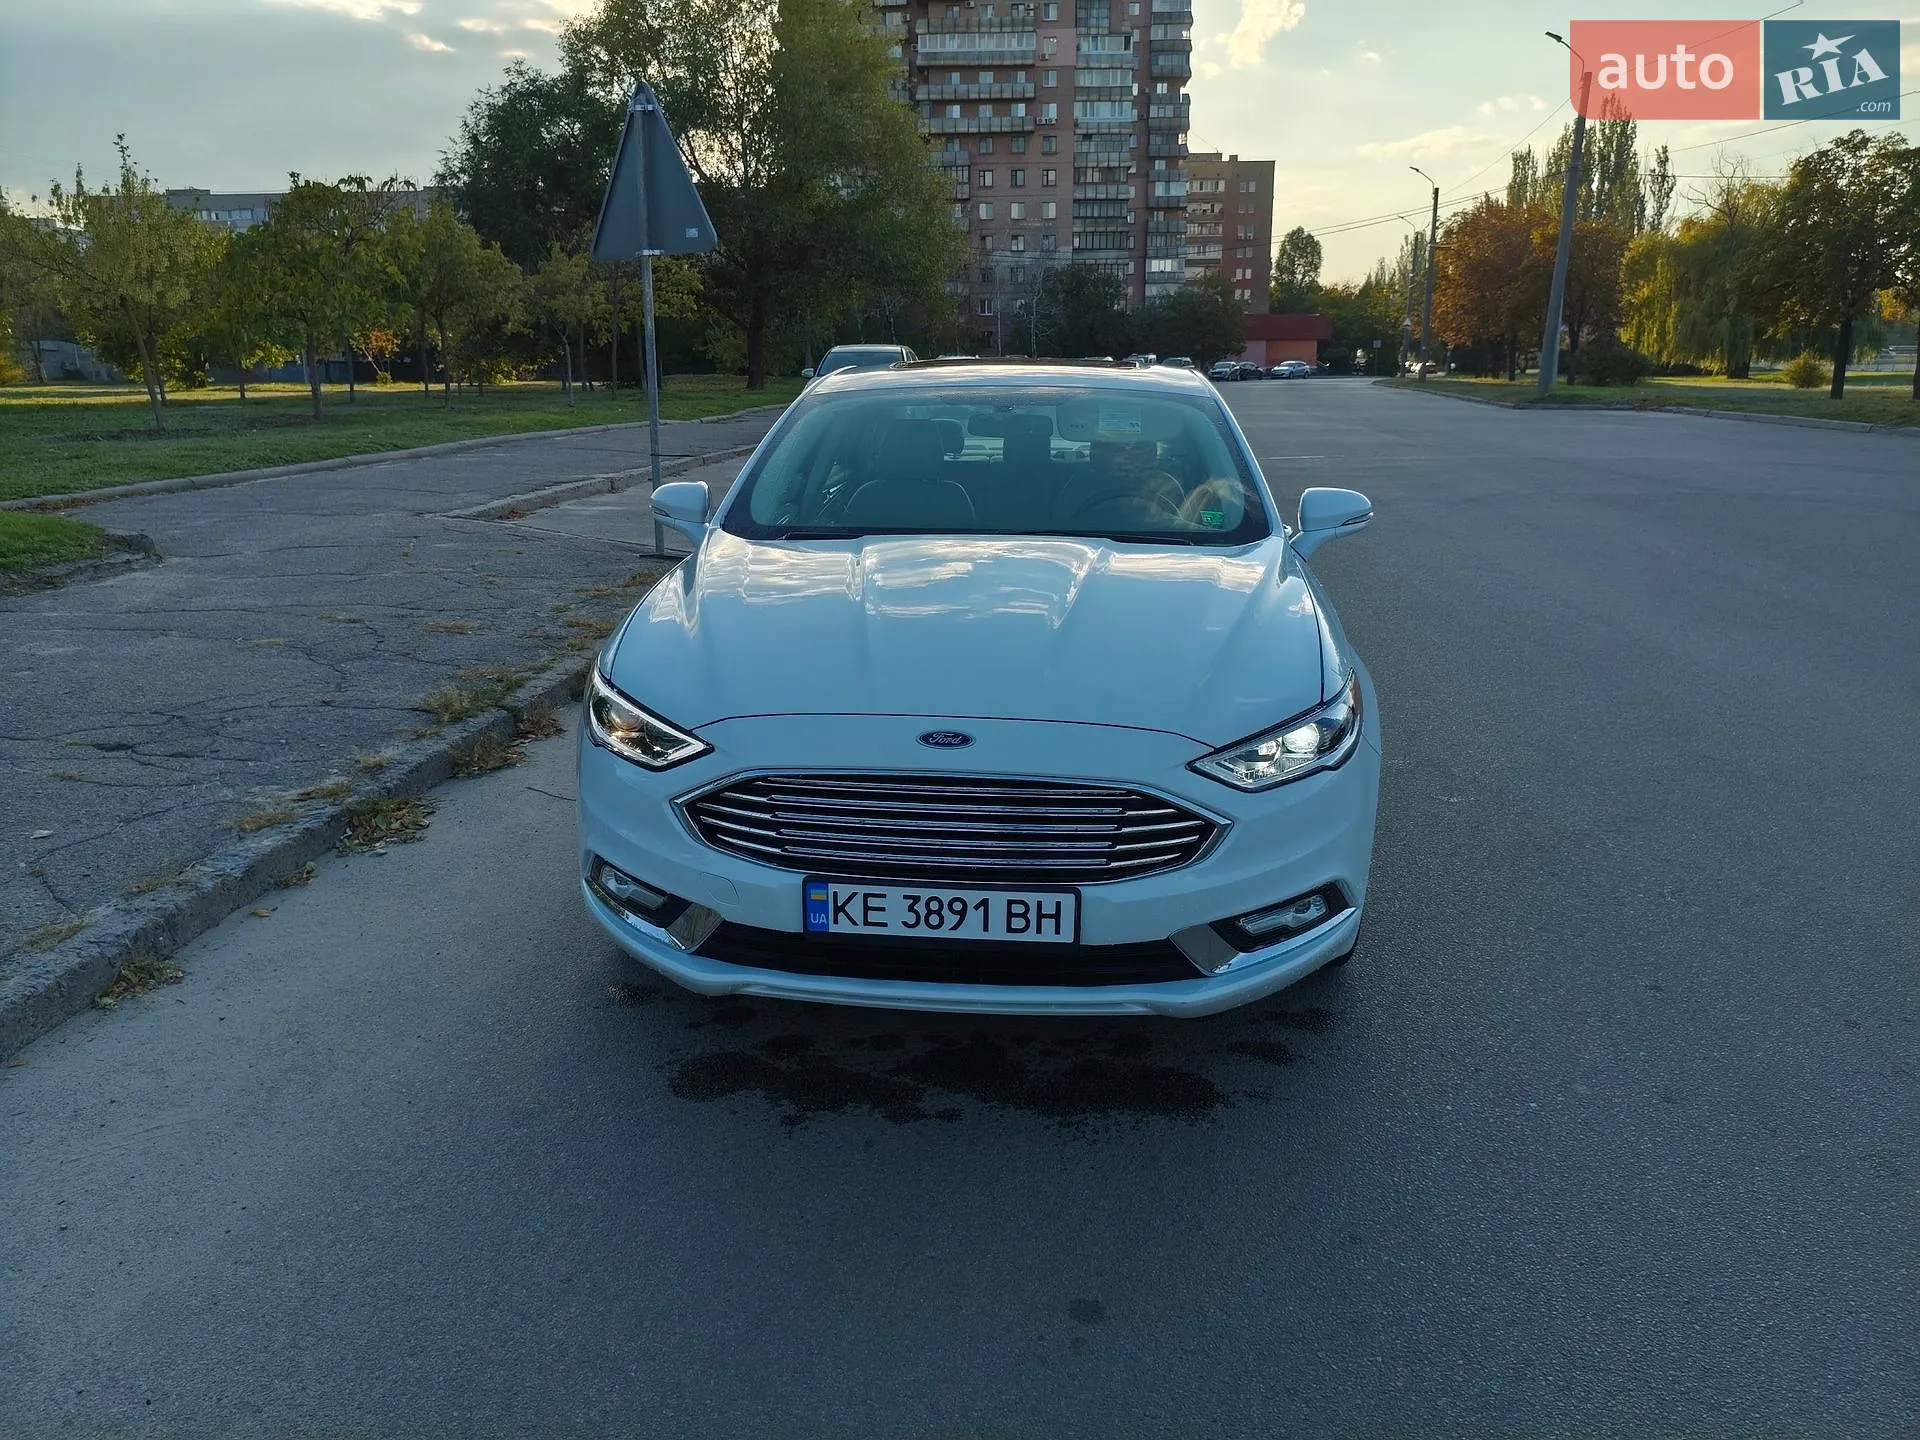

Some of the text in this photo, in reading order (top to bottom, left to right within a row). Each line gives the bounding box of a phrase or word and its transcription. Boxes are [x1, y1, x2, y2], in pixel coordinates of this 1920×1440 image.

[929, 732, 963, 744] Ford
[810, 913, 828, 925] UA
[832, 890, 1062, 936] KE 3891 BH
